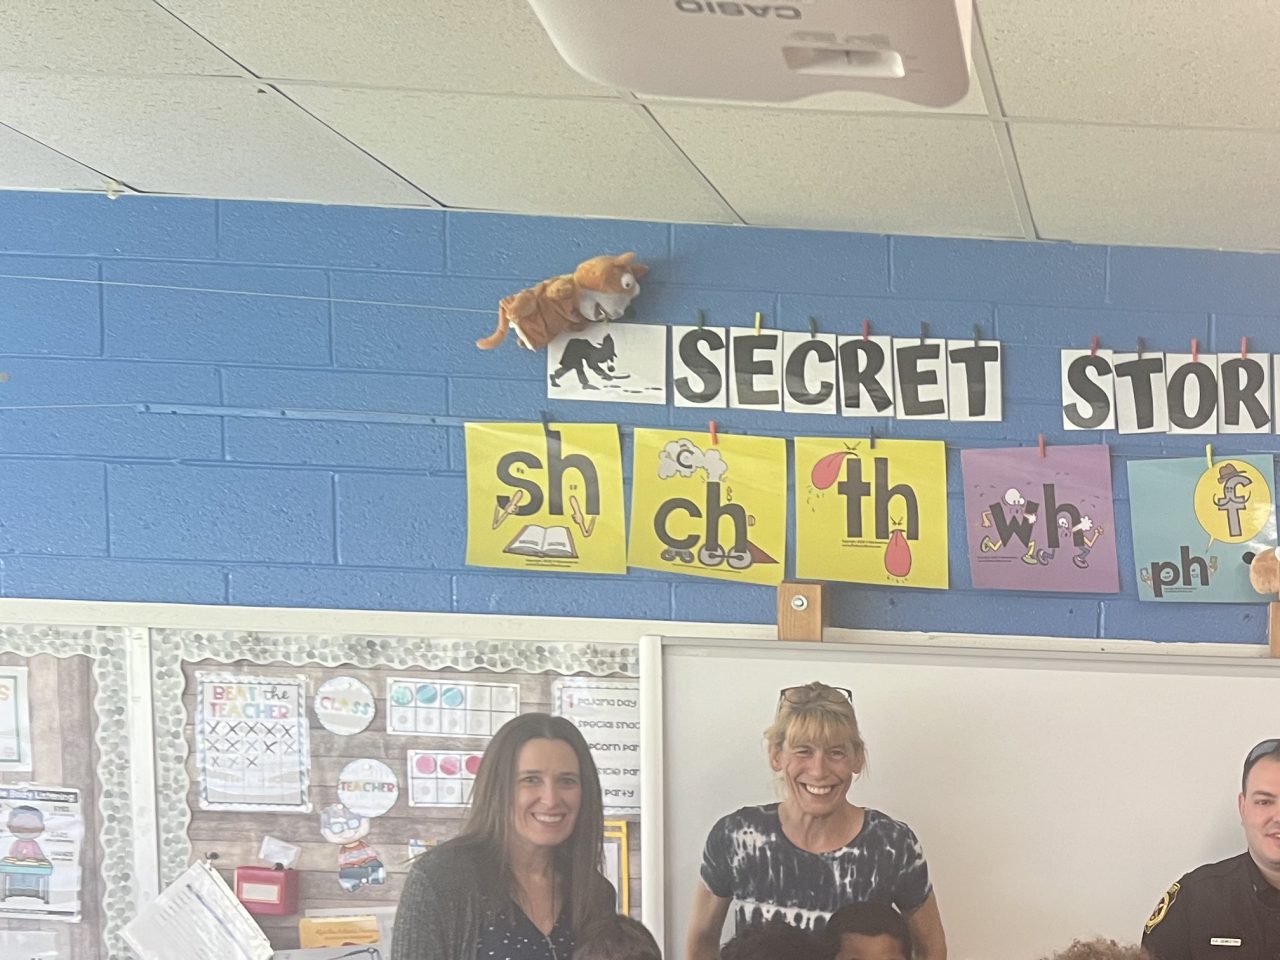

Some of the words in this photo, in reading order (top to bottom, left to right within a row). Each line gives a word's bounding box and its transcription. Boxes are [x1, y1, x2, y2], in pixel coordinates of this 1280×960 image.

[675, 0, 802, 20] CASIO
[674, 328, 999, 418] SECRET
[496, 430, 600, 517] sh
[837, 456, 920, 541] th
[654, 482, 748, 553] ch
[988, 484, 1085, 551] wh
[1151, 546, 1210, 598] ph
[210, 702, 290, 719] TEACHER
[213, 685, 258, 701] BEAT
[263, 686, 290, 701] the
[319, 696, 371, 717] CLASS
[341, 781, 396, 793] TEACHER
